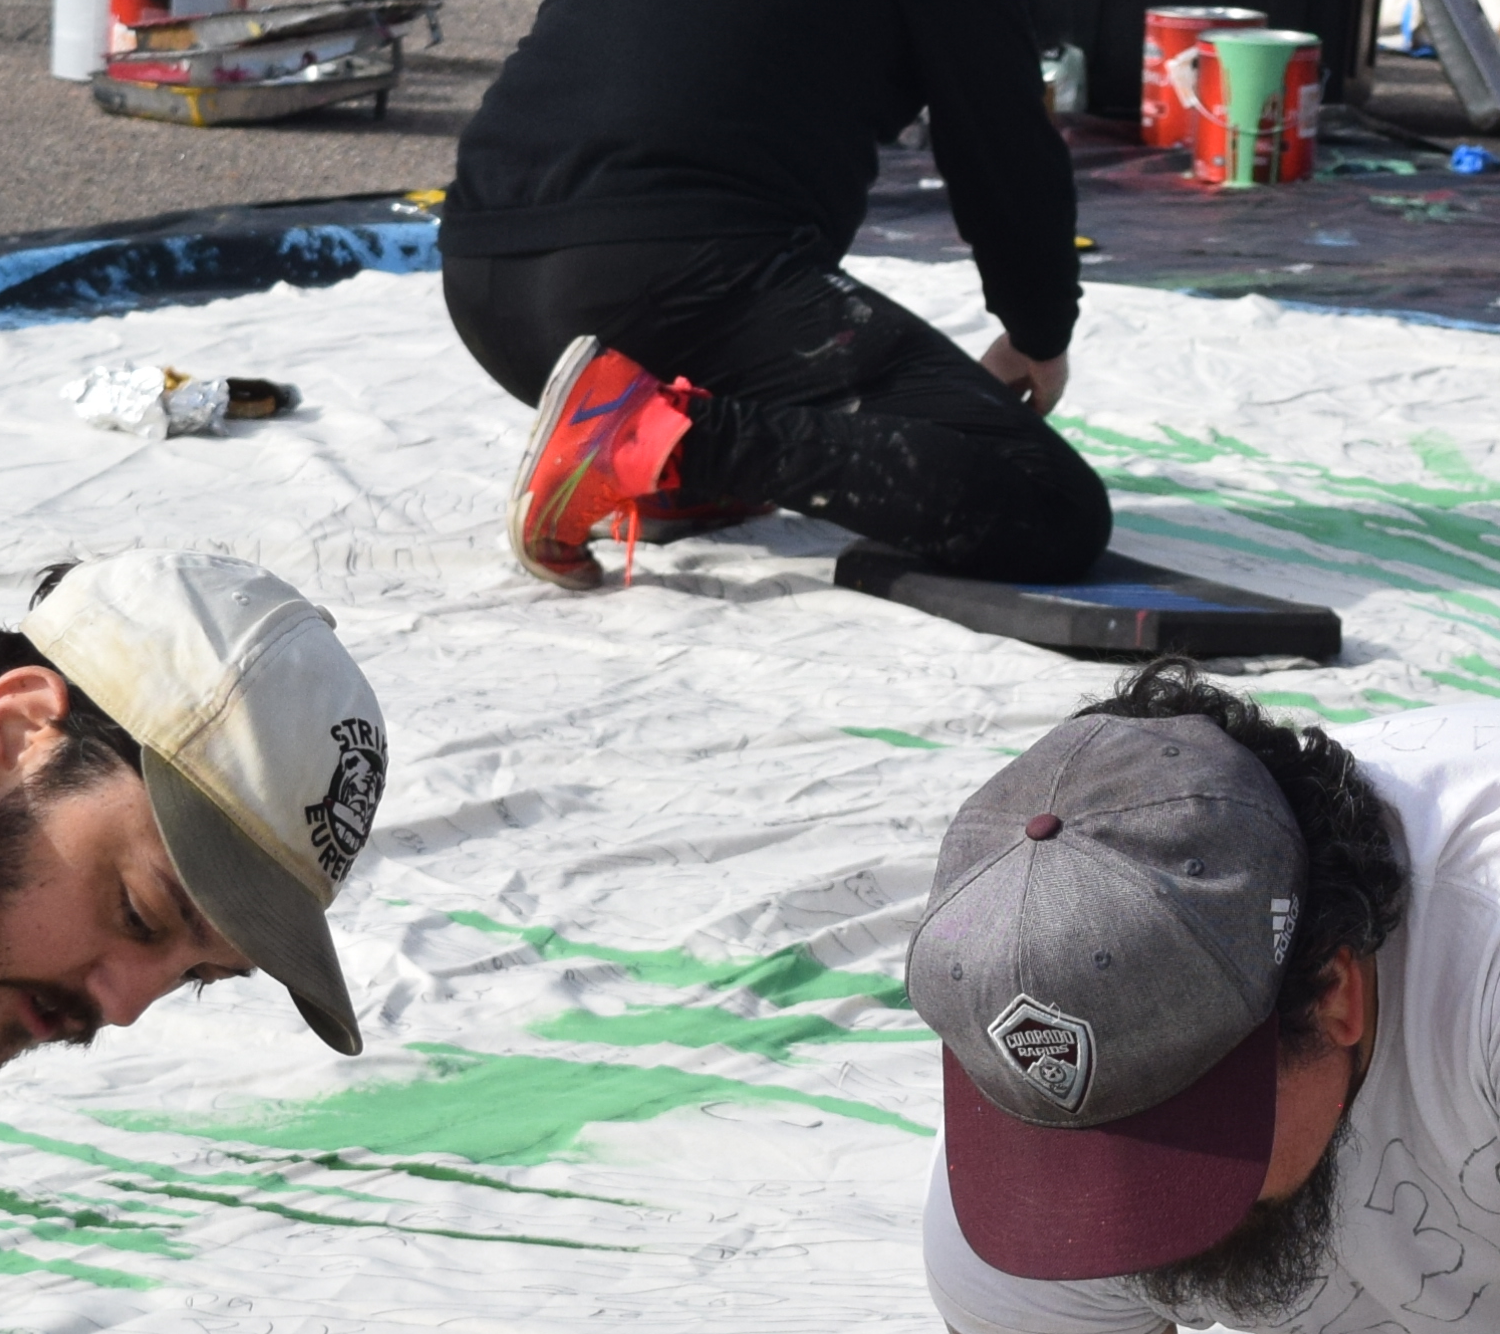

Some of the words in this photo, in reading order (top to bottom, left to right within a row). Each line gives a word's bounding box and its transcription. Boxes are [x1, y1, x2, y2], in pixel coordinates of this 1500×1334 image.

[1274, 892, 1300, 966] adidas
[1005, 1028, 1075, 1049] COLORADO
[1017, 1044, 1070, 1057] RAPIDS
